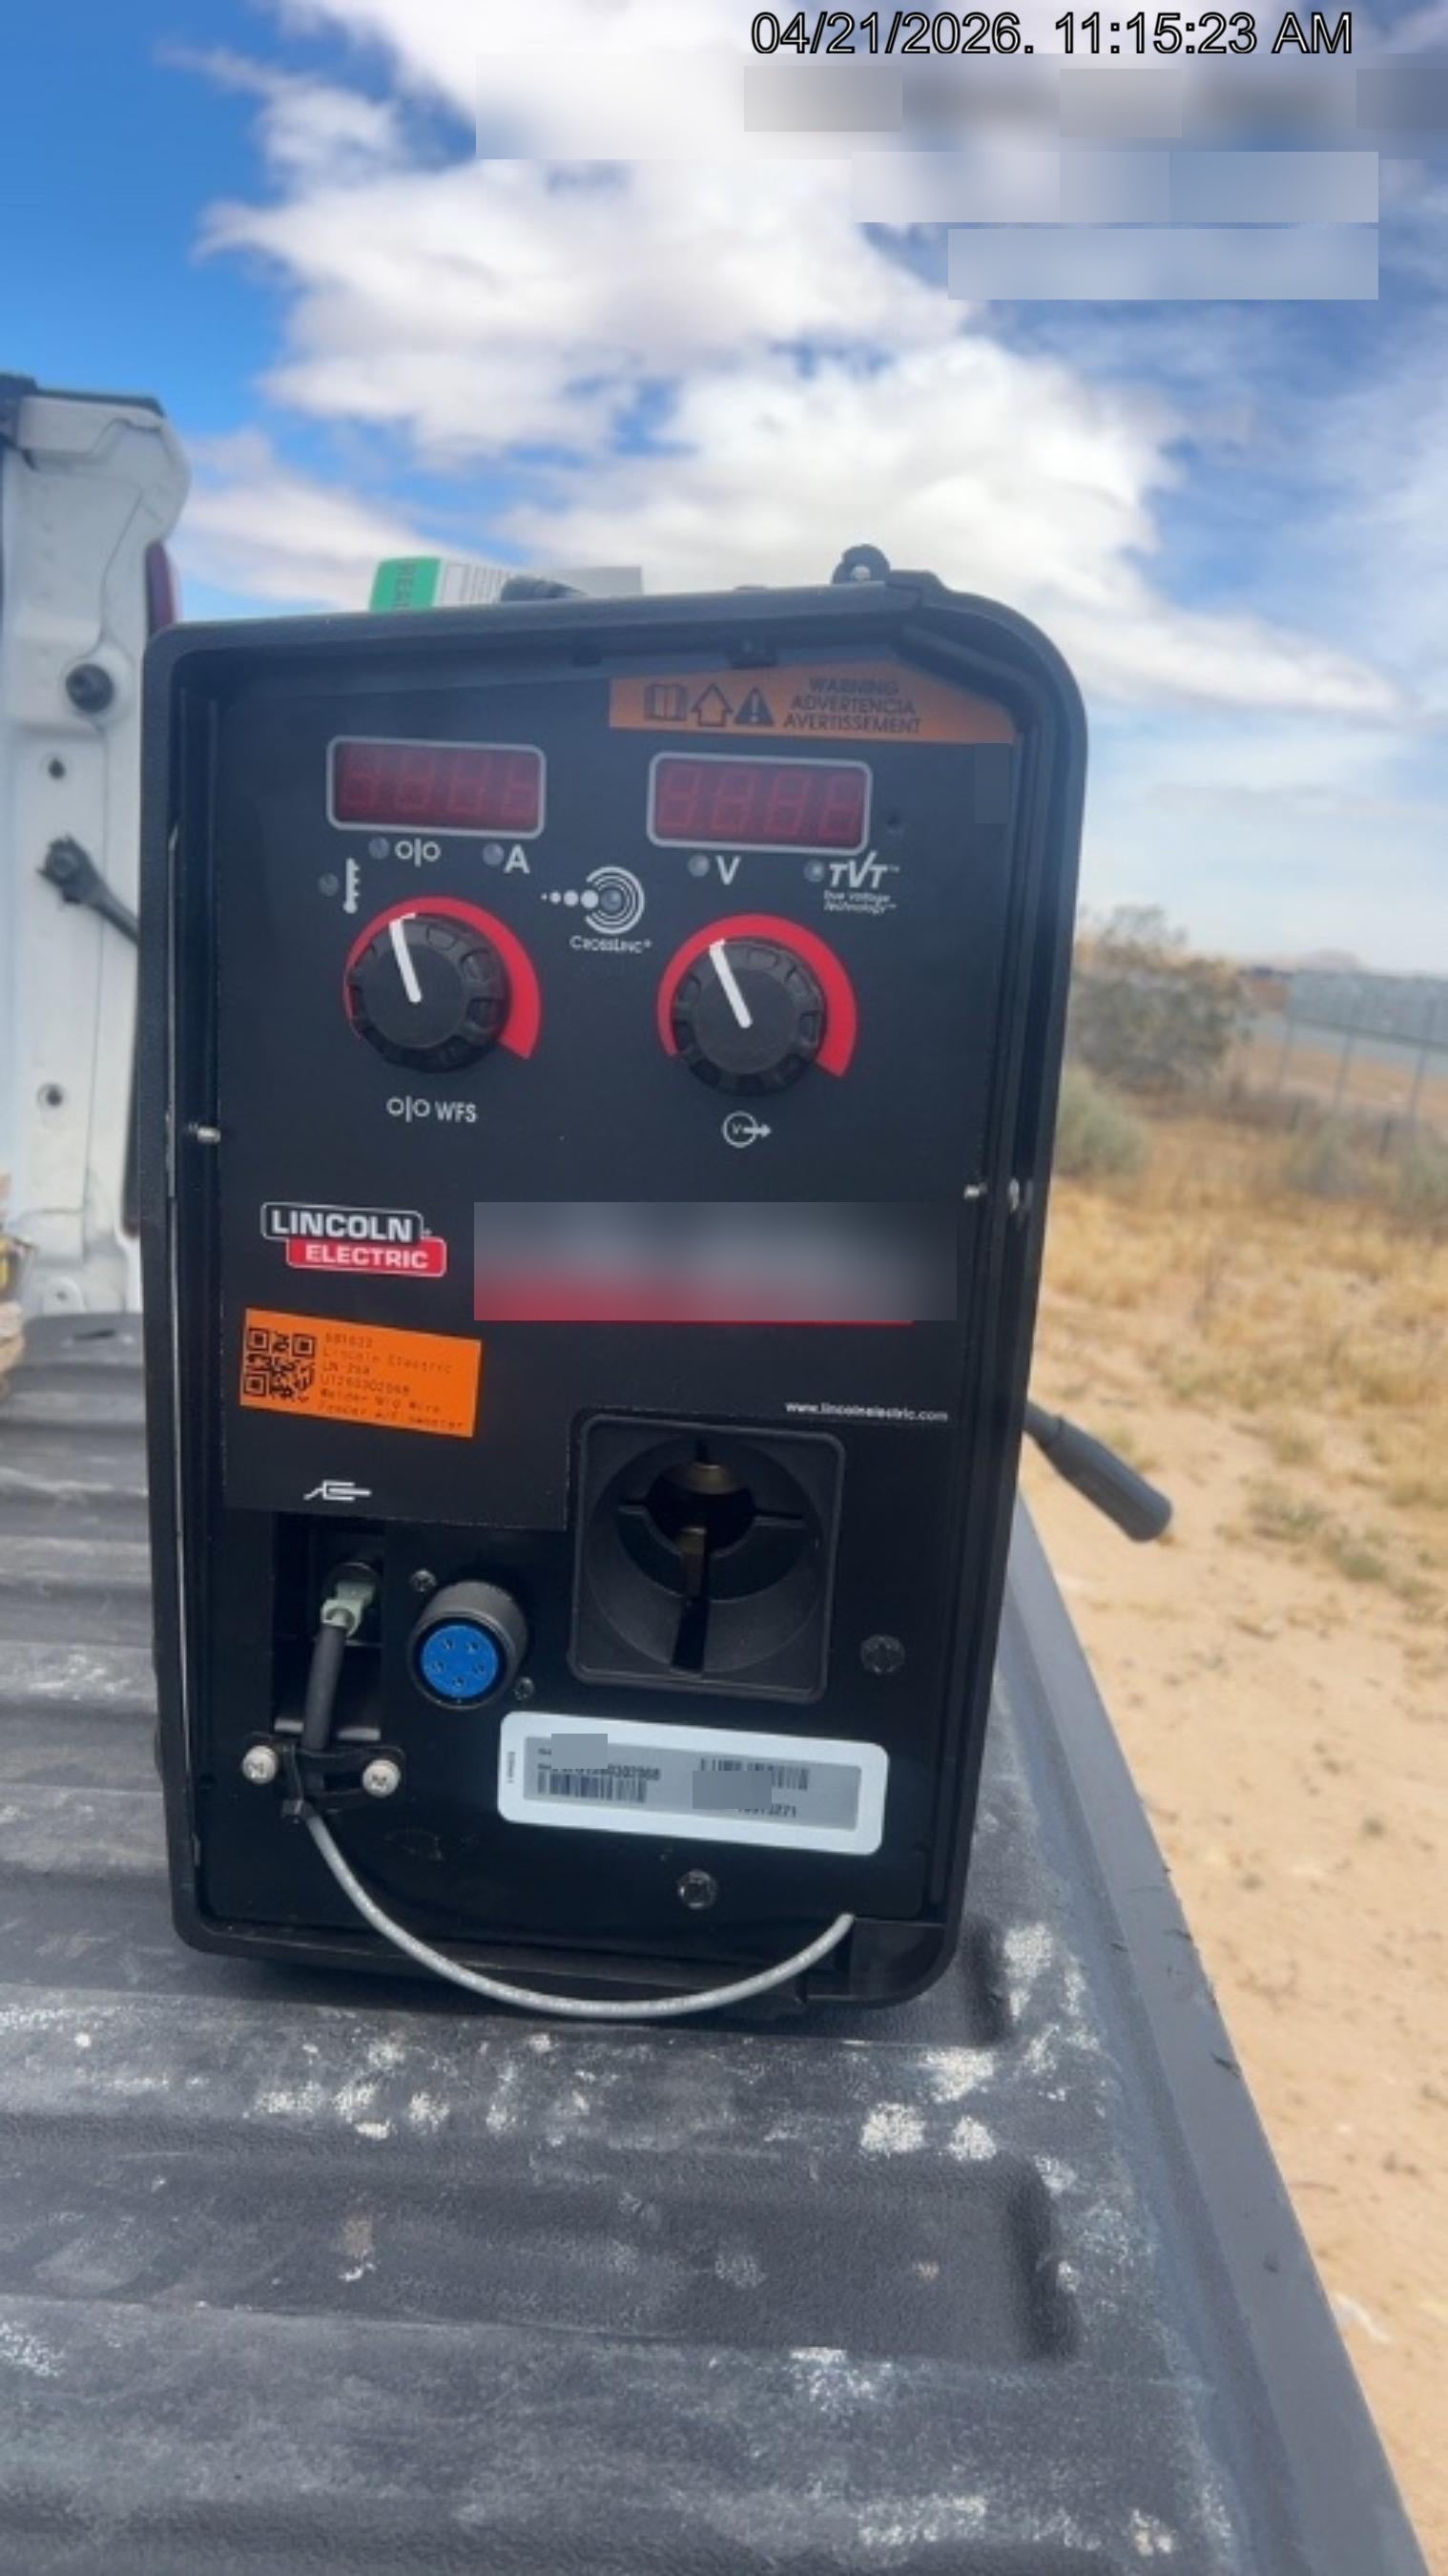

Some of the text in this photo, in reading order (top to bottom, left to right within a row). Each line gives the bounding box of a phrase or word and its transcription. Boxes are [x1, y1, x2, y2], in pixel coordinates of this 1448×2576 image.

[809, 678, 900, 696] WARNING
[791, 695, 917, 716] ADVERTENCIA
[783, 714, 922, 734] AVERTISSEMENT
[504, 847, 529, 874] A
[715, 856, 740, 885] V
[436, 1103, 478, 1123] WFS
[271, 1210, 412, 1242] LINCOLN
[304, 1244, 429, 1270] ELECTRIC
[785, 1402, 949, 1422] www.lincolnelectric.com
